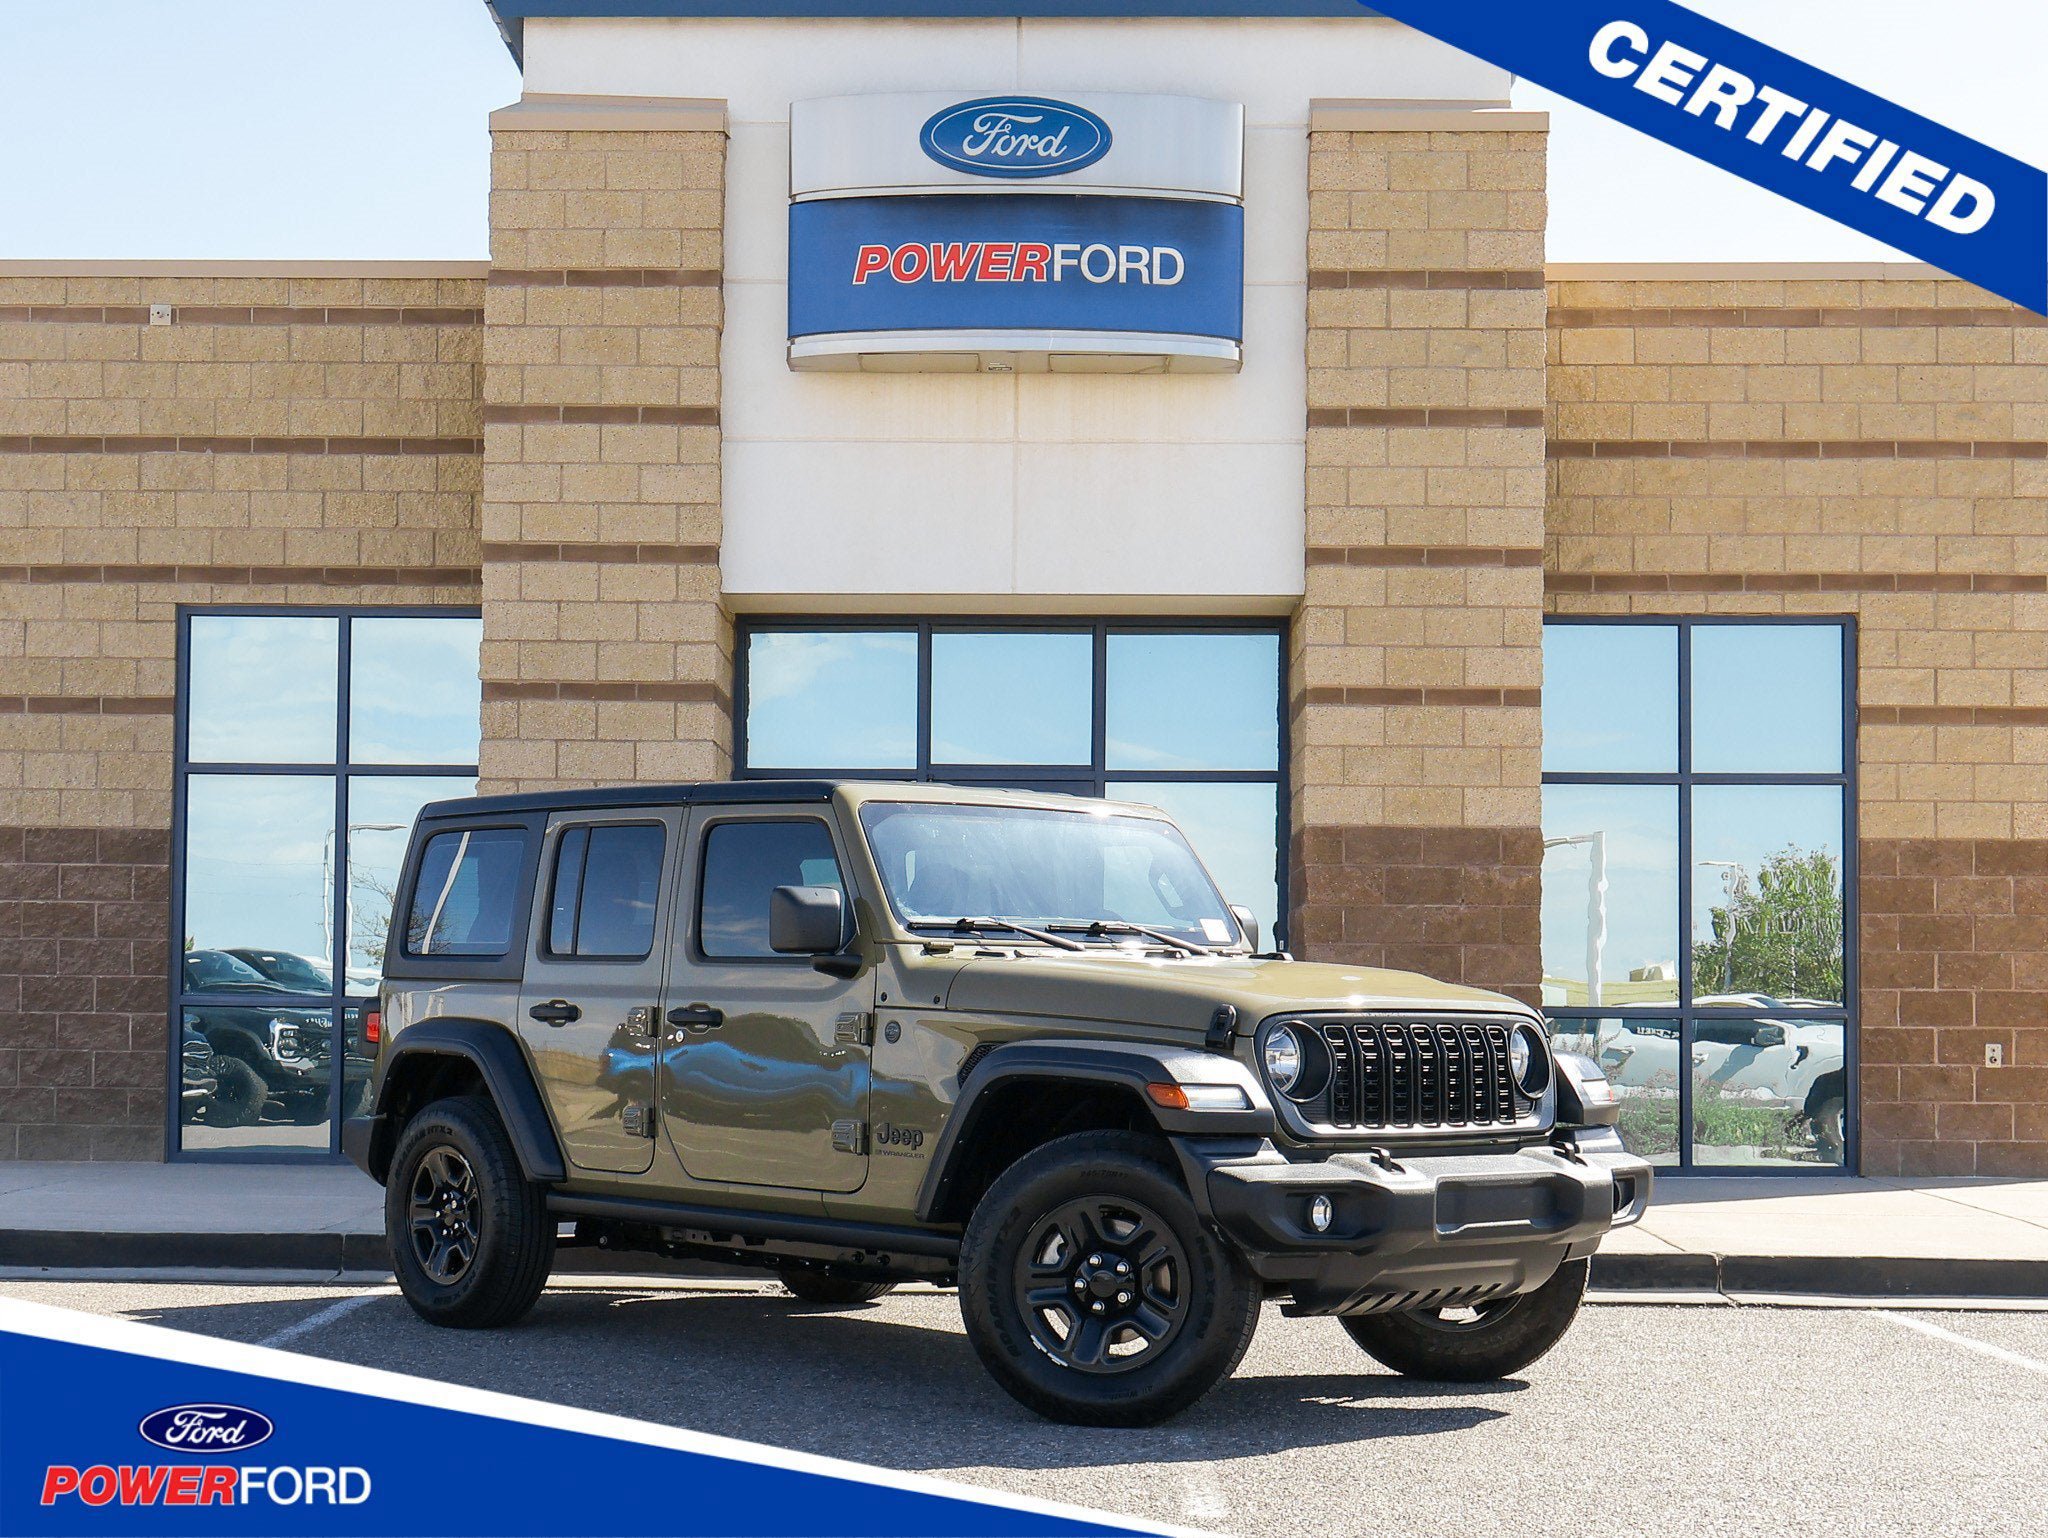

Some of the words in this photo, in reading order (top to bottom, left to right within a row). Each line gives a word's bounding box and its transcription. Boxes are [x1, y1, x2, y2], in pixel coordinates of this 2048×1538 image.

[962, 112, 1070, 158] Ford
[852, 242, 1185, 286] POWERFORD
[876, 1122, 924, 1151] Jeep
[883, 1150, 925, 1160] WRANGLER
